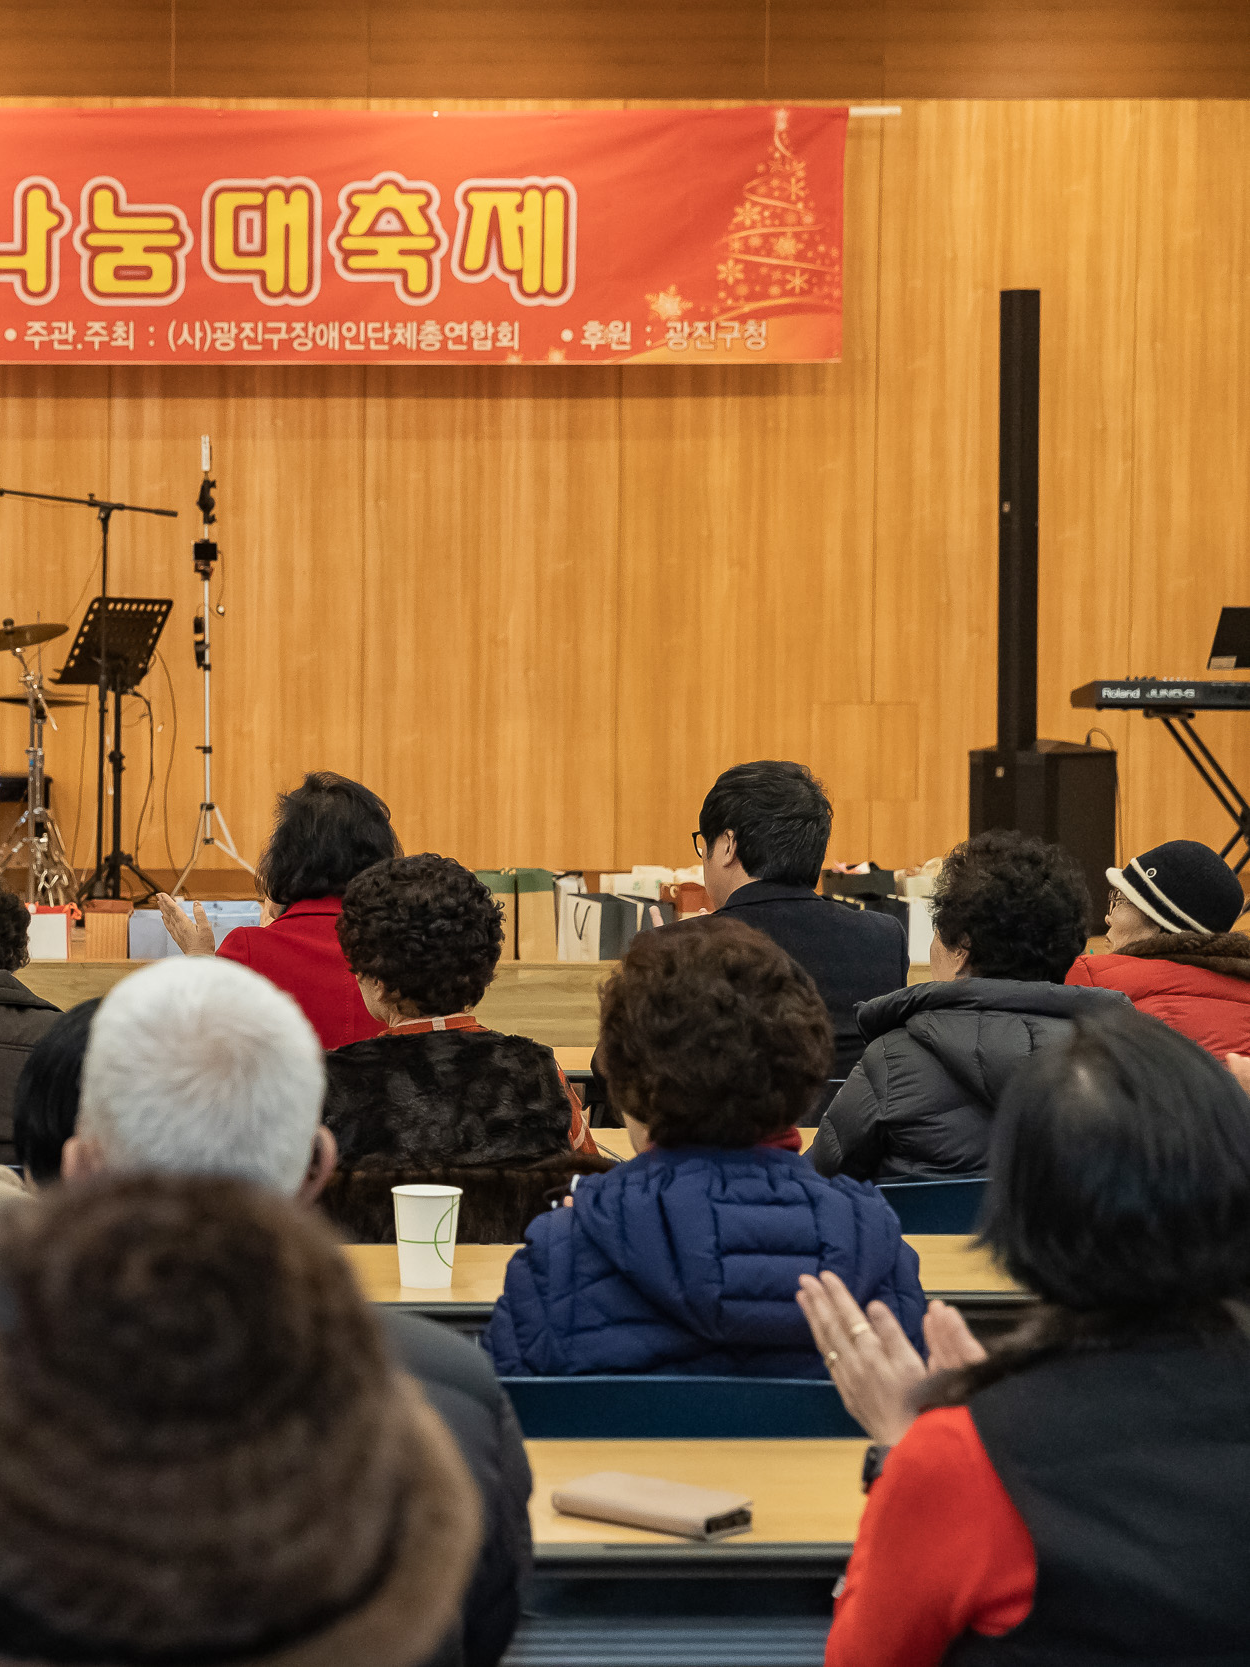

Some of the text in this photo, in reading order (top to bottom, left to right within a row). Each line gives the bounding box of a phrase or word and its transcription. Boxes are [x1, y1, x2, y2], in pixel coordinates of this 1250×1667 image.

[24, 320, 135, 350] 주관.주최
[167, 321, 519, 351] (사)광진구장애인단체총연합회
[580, 320, 632, 351] 후원
[666, 320, 768, 351] 광진구청
[1101, 687, 1141, 699] Roland
